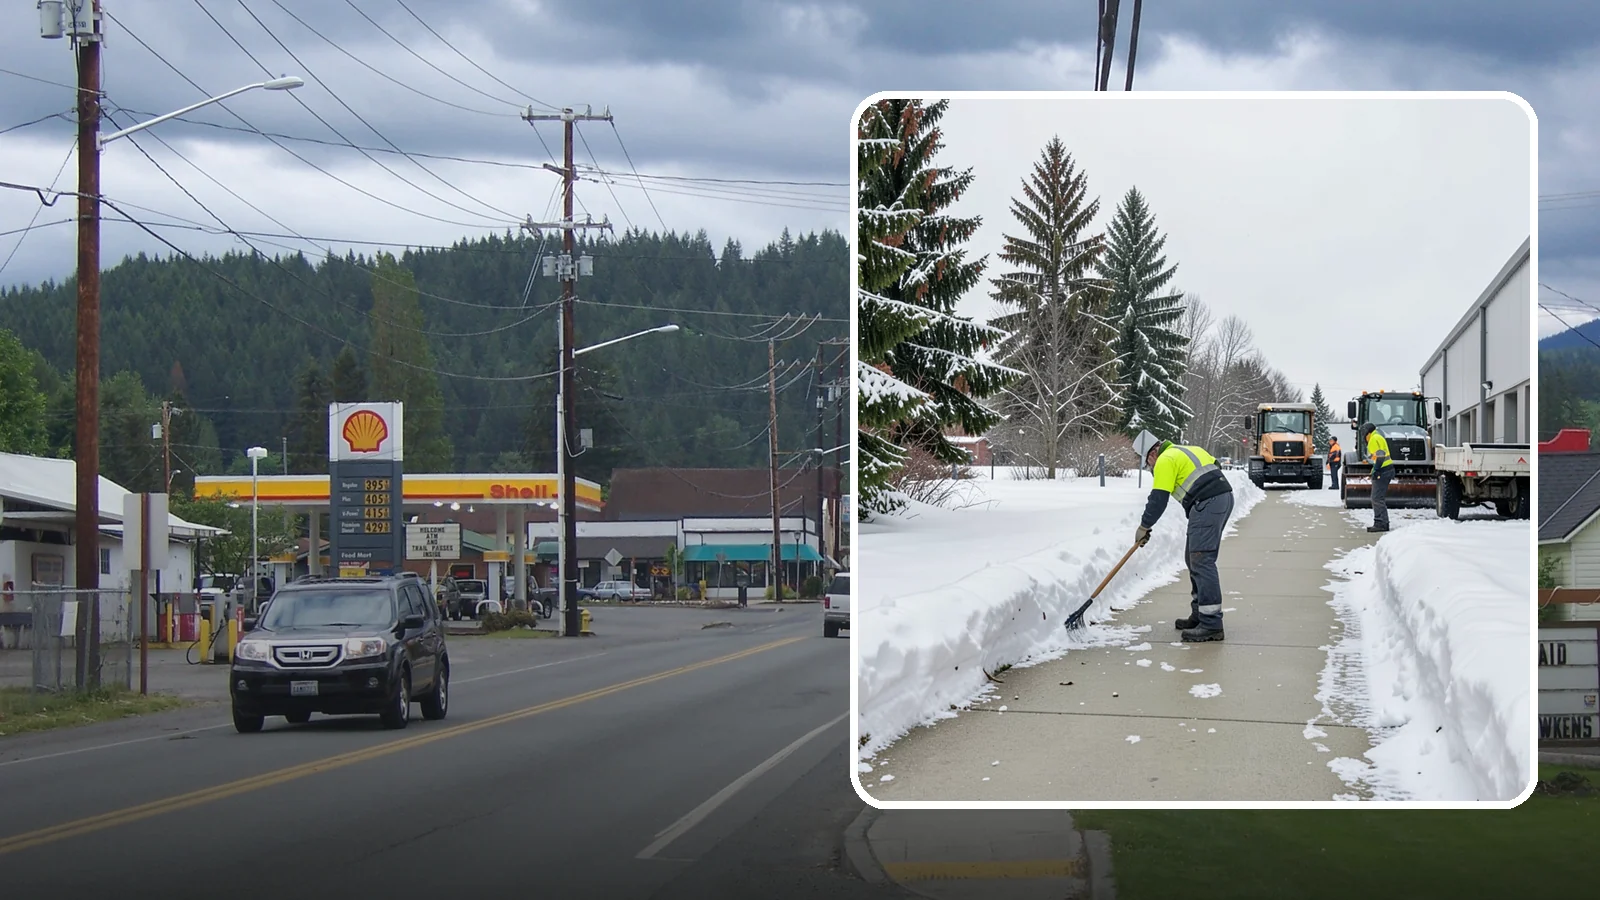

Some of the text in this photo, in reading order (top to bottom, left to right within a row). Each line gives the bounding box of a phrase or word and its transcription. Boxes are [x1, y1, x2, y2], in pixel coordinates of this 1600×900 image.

[366, 480, 383, 490] 395
[490, 484, 547, 499] Shell
[365, 494, 383, 504] 405
[365, 508, 383, 518] 415
[365, 522, 383, 532] 429
